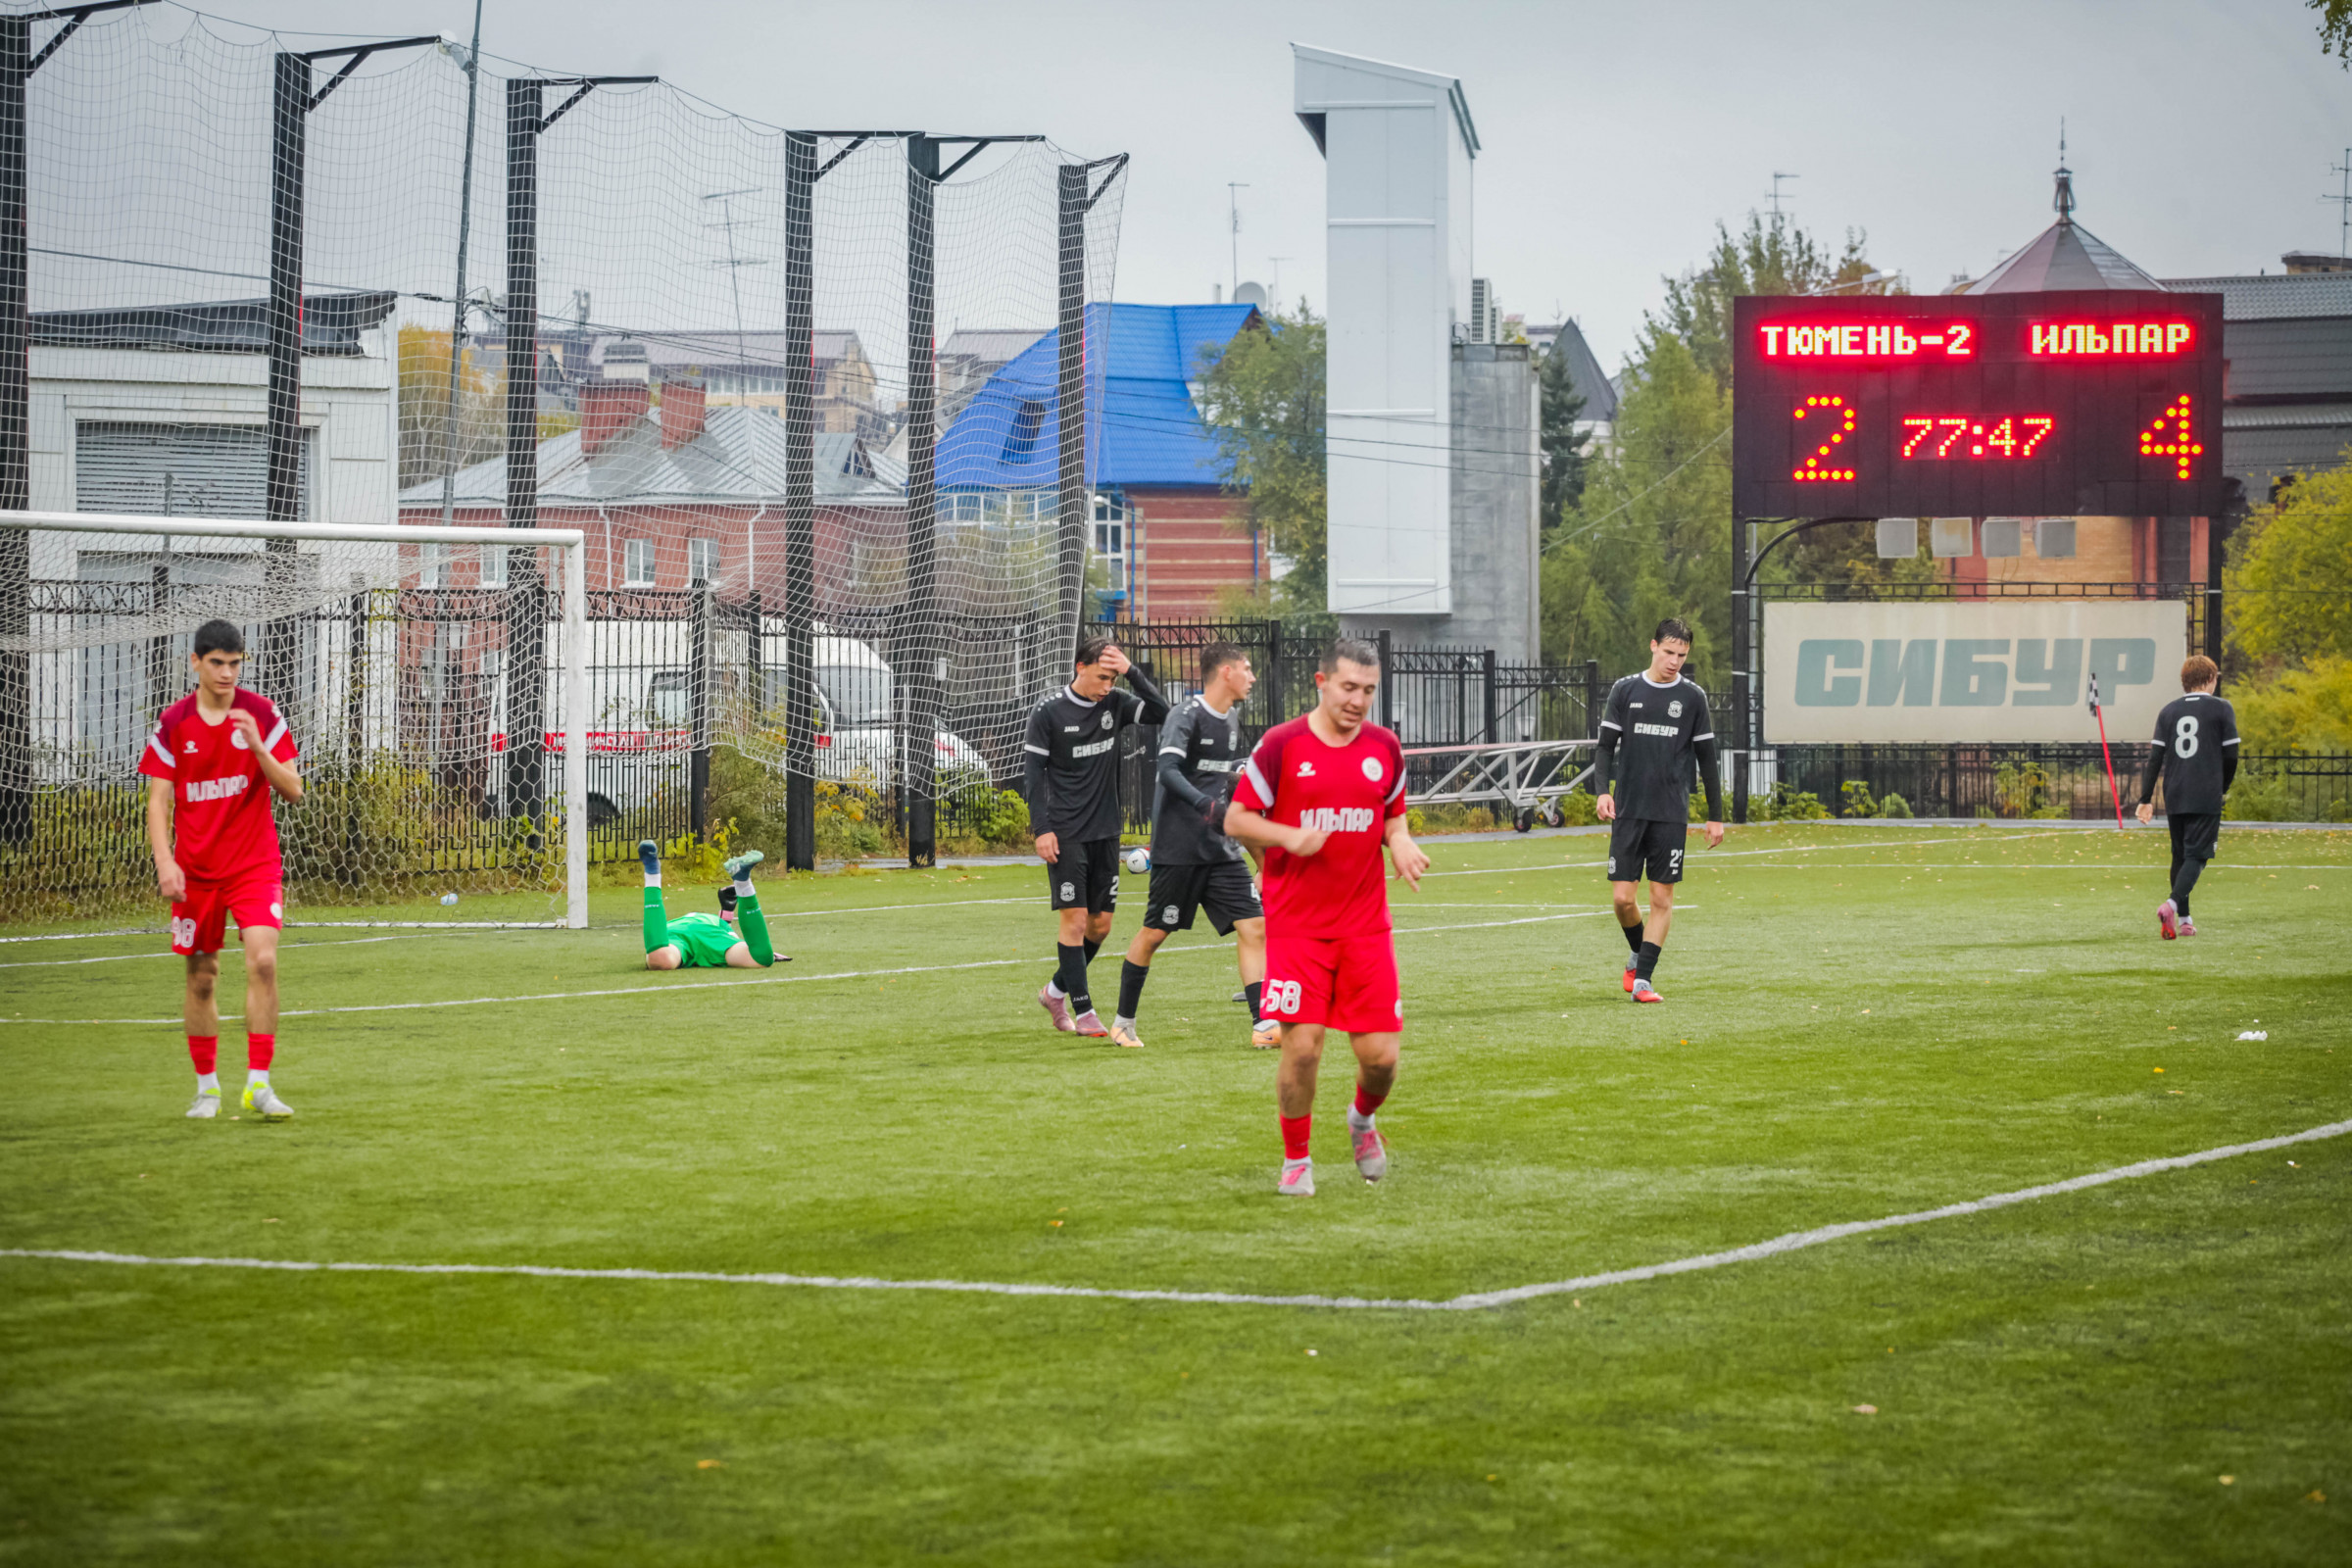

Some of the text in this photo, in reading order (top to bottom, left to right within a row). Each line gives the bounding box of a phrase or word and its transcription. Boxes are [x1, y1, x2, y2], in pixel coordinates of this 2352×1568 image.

[1760, 325, 1972, 356] ТЮМЕНЬ-2
[2032, 324, 2191, 354] ИЛЬПАР
[1793, 396, 1855, 481] 2
[1903, 417, 2053, 458] 77:47
[2139, 394, 2203, 480] 4
[1794, 638, 2156, 707] СИБУР
[1634, 722, 1679, 737] СИБУР
[2175, 715, 2199, 759] 8
[1072, 737, 1114, 759] СИБУР
[186, 774, 248, 803] ИЛЬПАР
[1299, 807, 1374, 832] ИЛЬПАР
[1260, 979, 1302, 1015] 58
